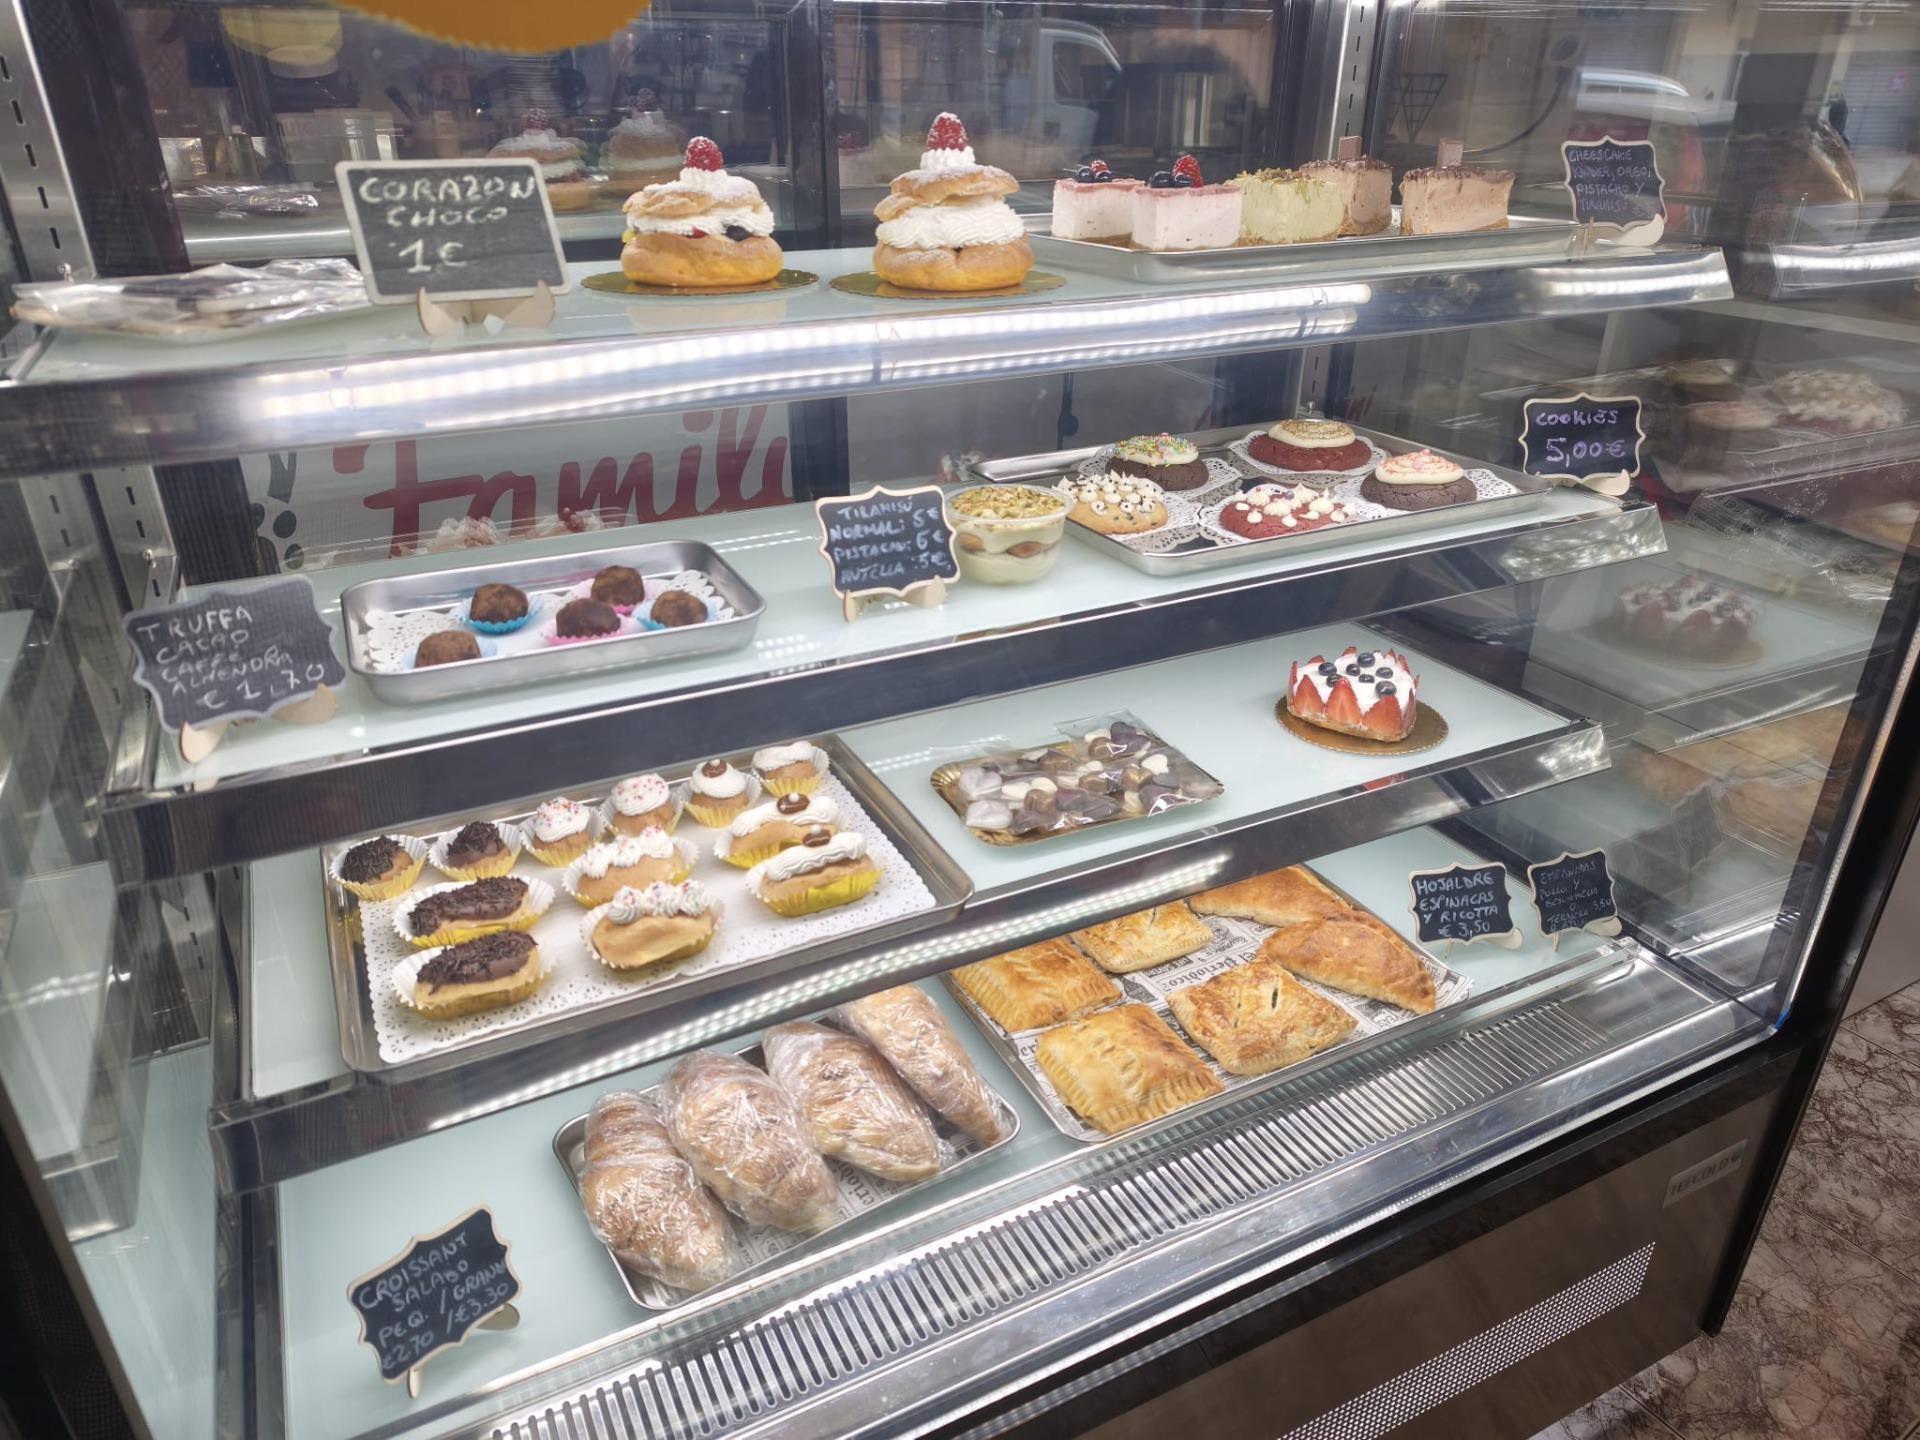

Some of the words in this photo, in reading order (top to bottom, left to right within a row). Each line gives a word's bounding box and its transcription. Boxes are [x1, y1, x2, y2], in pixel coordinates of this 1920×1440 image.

[359, 174, 535, 203] CORAZON
[386, 205, 509, 227] CHOCO
[136, 605, 253, 642] TRUFFA
[156, 629, 249, 665] CACAO
[1415, 872, 1496, 896] HOJALDRE
[1419, 890, 1496, 911] ESPINACAS
[1423, 912, 1433, 925] Y
[1440, 904, 1499, 924] RICOTTA
[1438, 923, 1453, 938] €
[1458, 919, 1491, 938] 3,50
[358, 1232, 468, 1309] CROISSANT
[393, 1260, 469, 1312] SALADO
